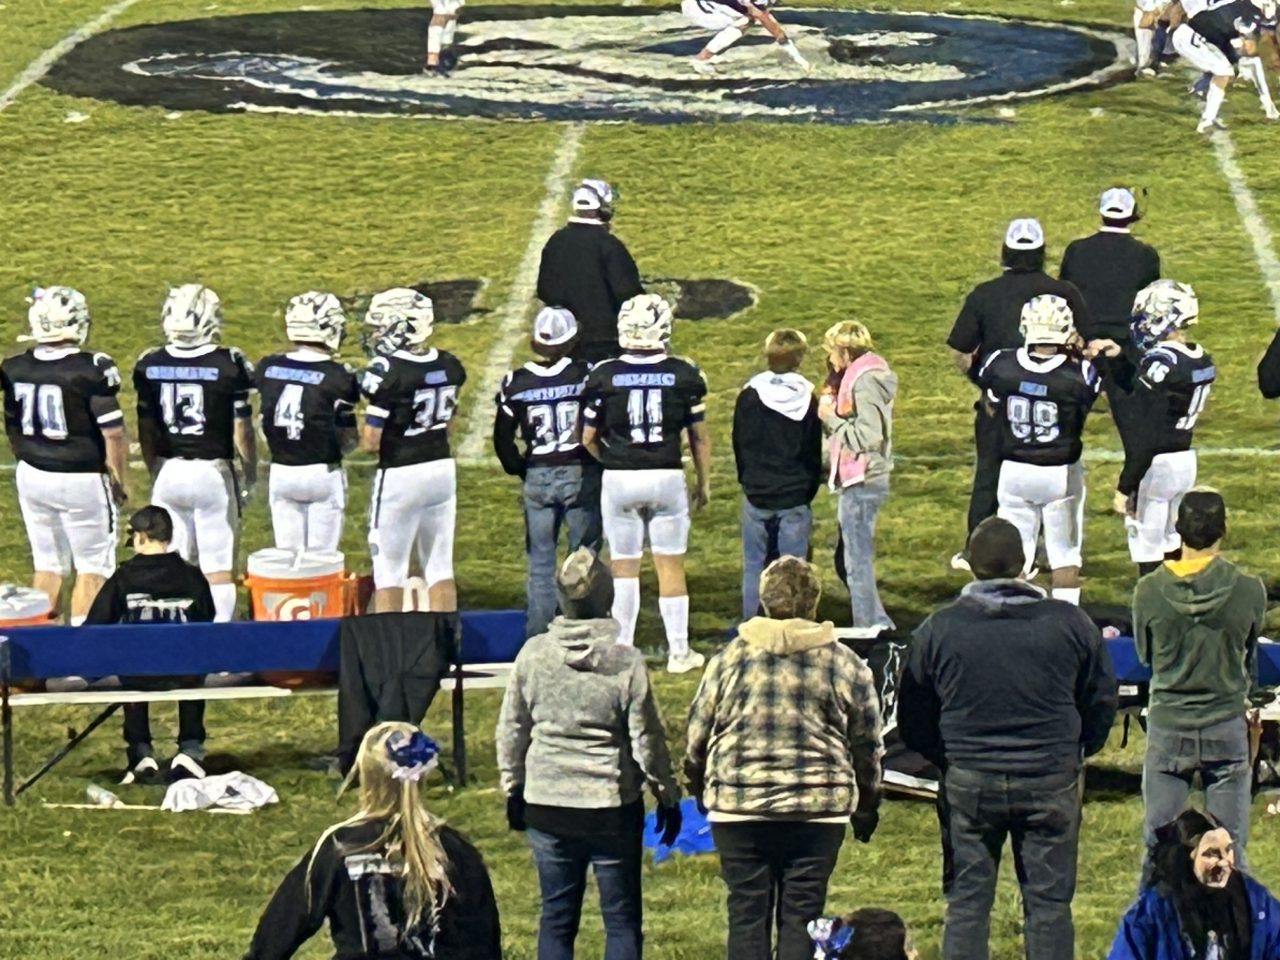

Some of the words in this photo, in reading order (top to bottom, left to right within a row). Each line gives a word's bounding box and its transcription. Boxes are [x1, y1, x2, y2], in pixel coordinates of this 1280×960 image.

[14, 381, 69, 440] 70
[160, 381, 207, 436] 13
[273, 383, 305, 440] 4
[626, 388, 664, 444] 11
